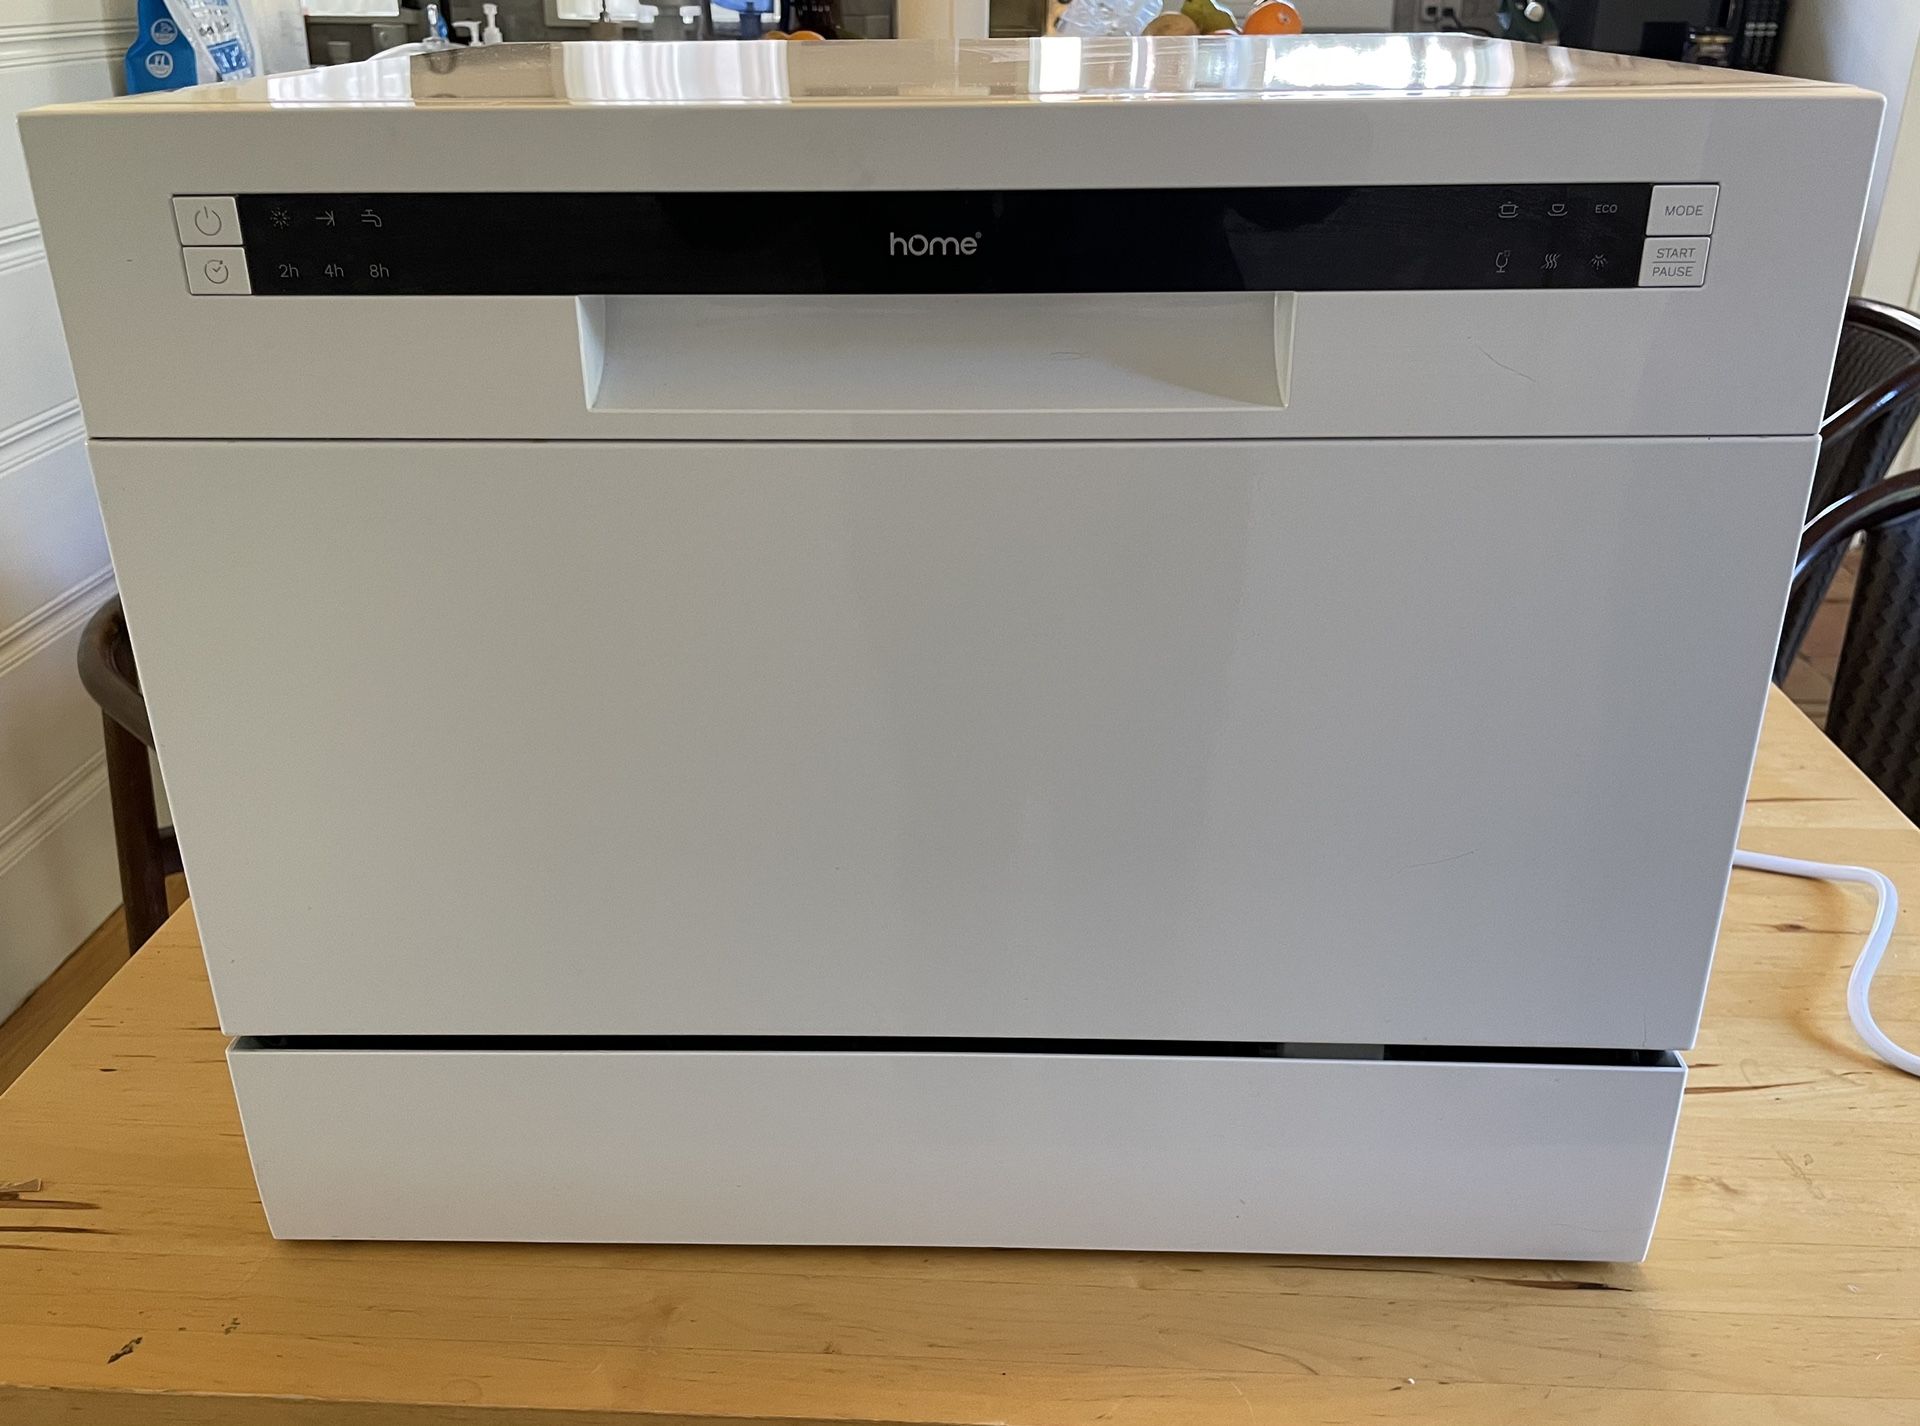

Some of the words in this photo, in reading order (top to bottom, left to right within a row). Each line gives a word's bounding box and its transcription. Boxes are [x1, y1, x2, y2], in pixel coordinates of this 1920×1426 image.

[1595, 204, 1618, 214] ECO
[1664, 205, 1704, 216] MODE
[1656, 247, 1697, 259] START
[278, 264, 300, 278] 2h
[324, 264, 344, 278] 4h
[369, 264, 390, 278] 8h
[1652, 266, 1694, 277] PAUSE
